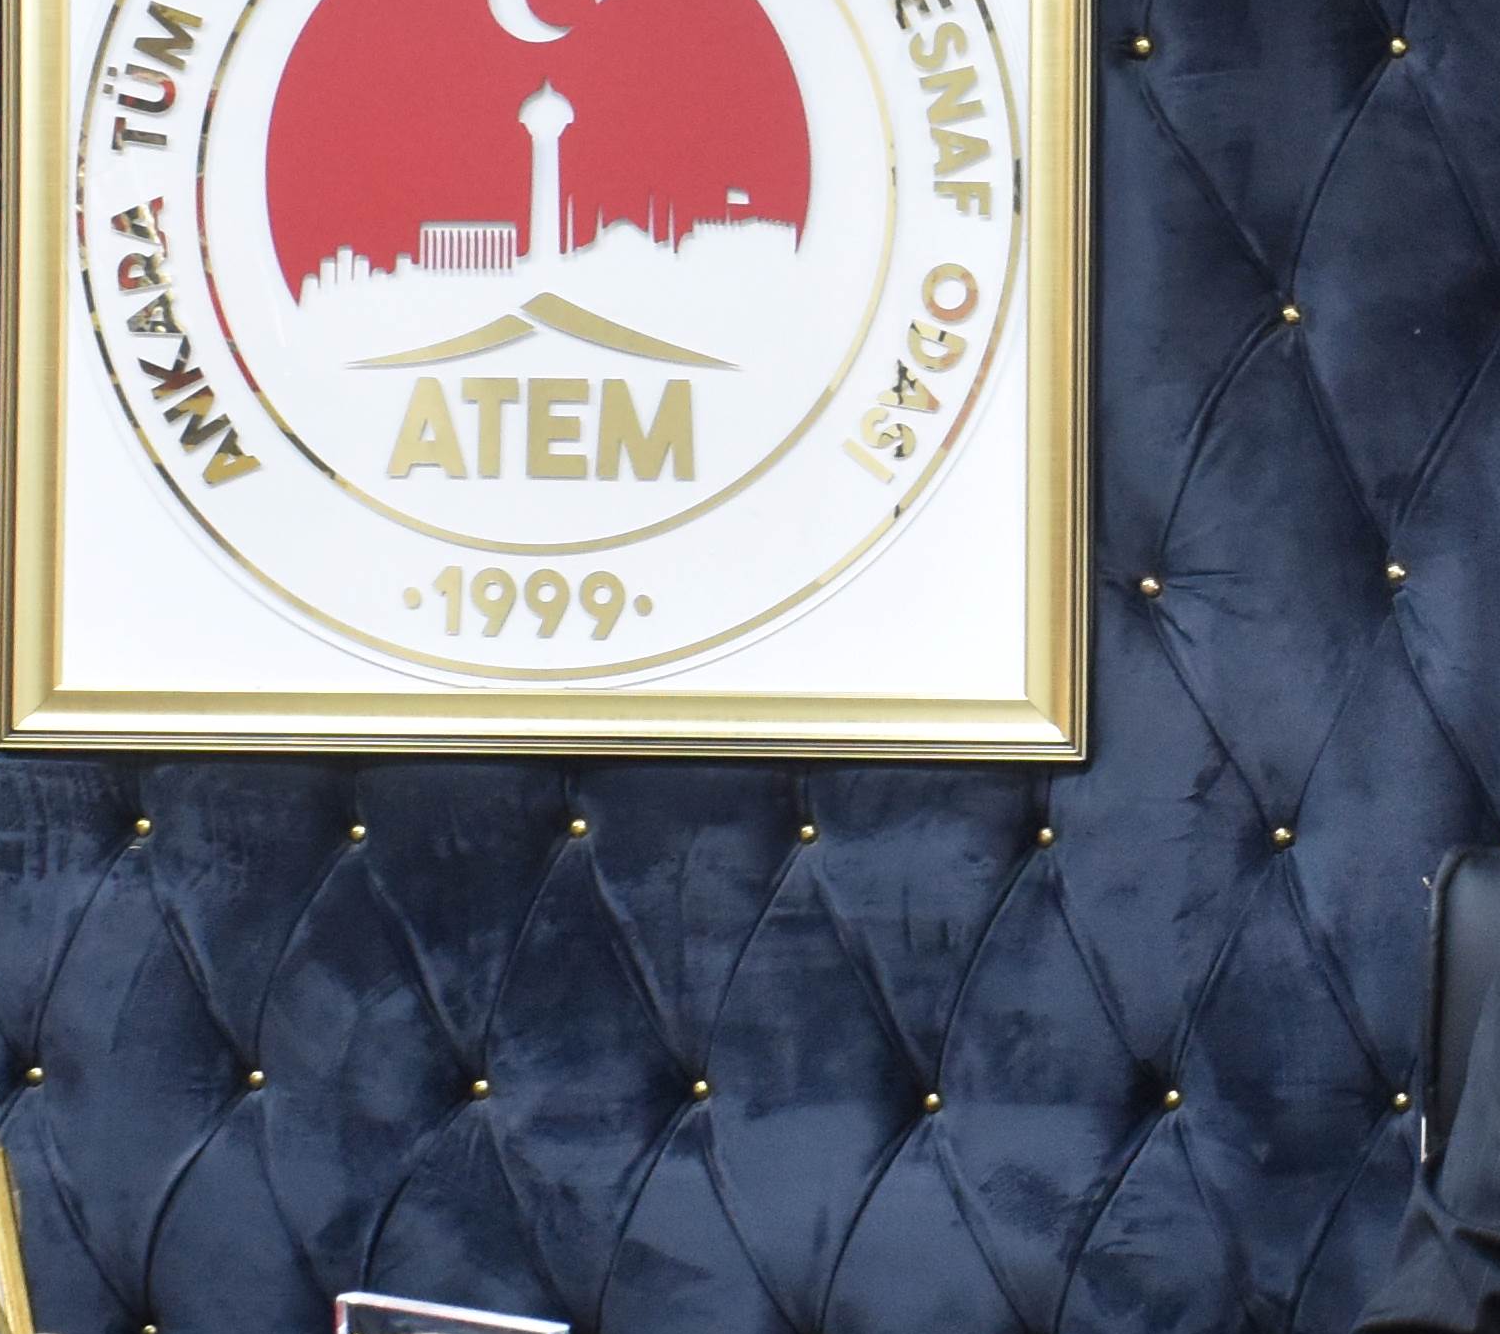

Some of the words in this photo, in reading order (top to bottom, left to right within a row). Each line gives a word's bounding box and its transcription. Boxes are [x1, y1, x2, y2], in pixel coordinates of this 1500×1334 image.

[102, 0, 204, 157] TÜM
[111, 192, 262, 485] ANKARA
[839, 262, 980, 484] ODASI
[386, 376, 697, 483] ATEM
[431, 565, 627, 642] 1999
